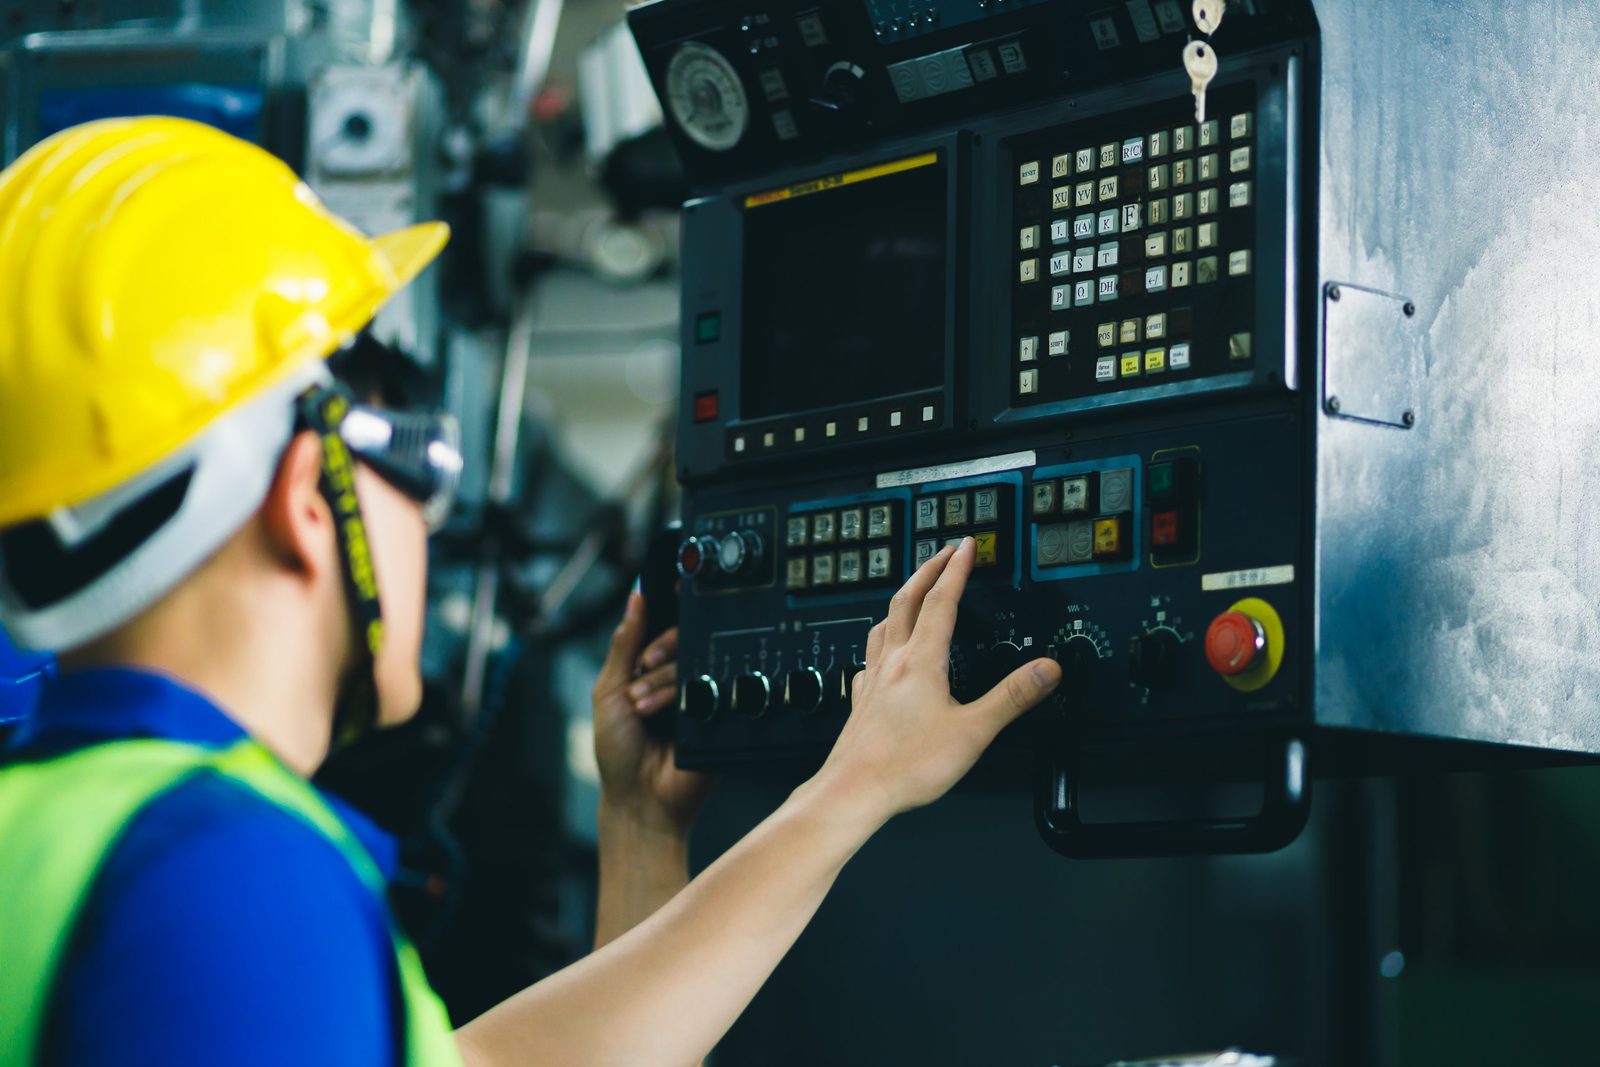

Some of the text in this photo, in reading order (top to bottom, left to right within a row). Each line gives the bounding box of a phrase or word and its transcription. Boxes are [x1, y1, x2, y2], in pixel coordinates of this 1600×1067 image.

[1203, 128, 1209, 137] 9
[1152, 140, 1158, 150] 7
[1176, 135, 1183, 145] 8
[1101, 151, 1114, 163] GE
[1176, 167, 1184, 177] 5
[1203, 162, 1209, 172] 6
[1151, 172, 1158, 182] 4
[1078, 189, 1091, 201] YV
[1100, 183, 1115, 196] ZW
[1054, 192, 1067, 204] XU
[1201, 197, 1207, 208] 3
[1176, 201, 1182, 212] 2
[1124, 205, 1136, 226] F
[1074, 220, 1091, 234] J(A)
[1103, 218, 1110, 230] K
[1077, 258, 1083, 268] S
[1103, 252, 1110, 263] T
[1053, 260, 1062, 271] M
[1100, 281, 1113, 293] DH
[1056, 292, 1063, 302] P
[1098, 332, 1110, 341] POS
